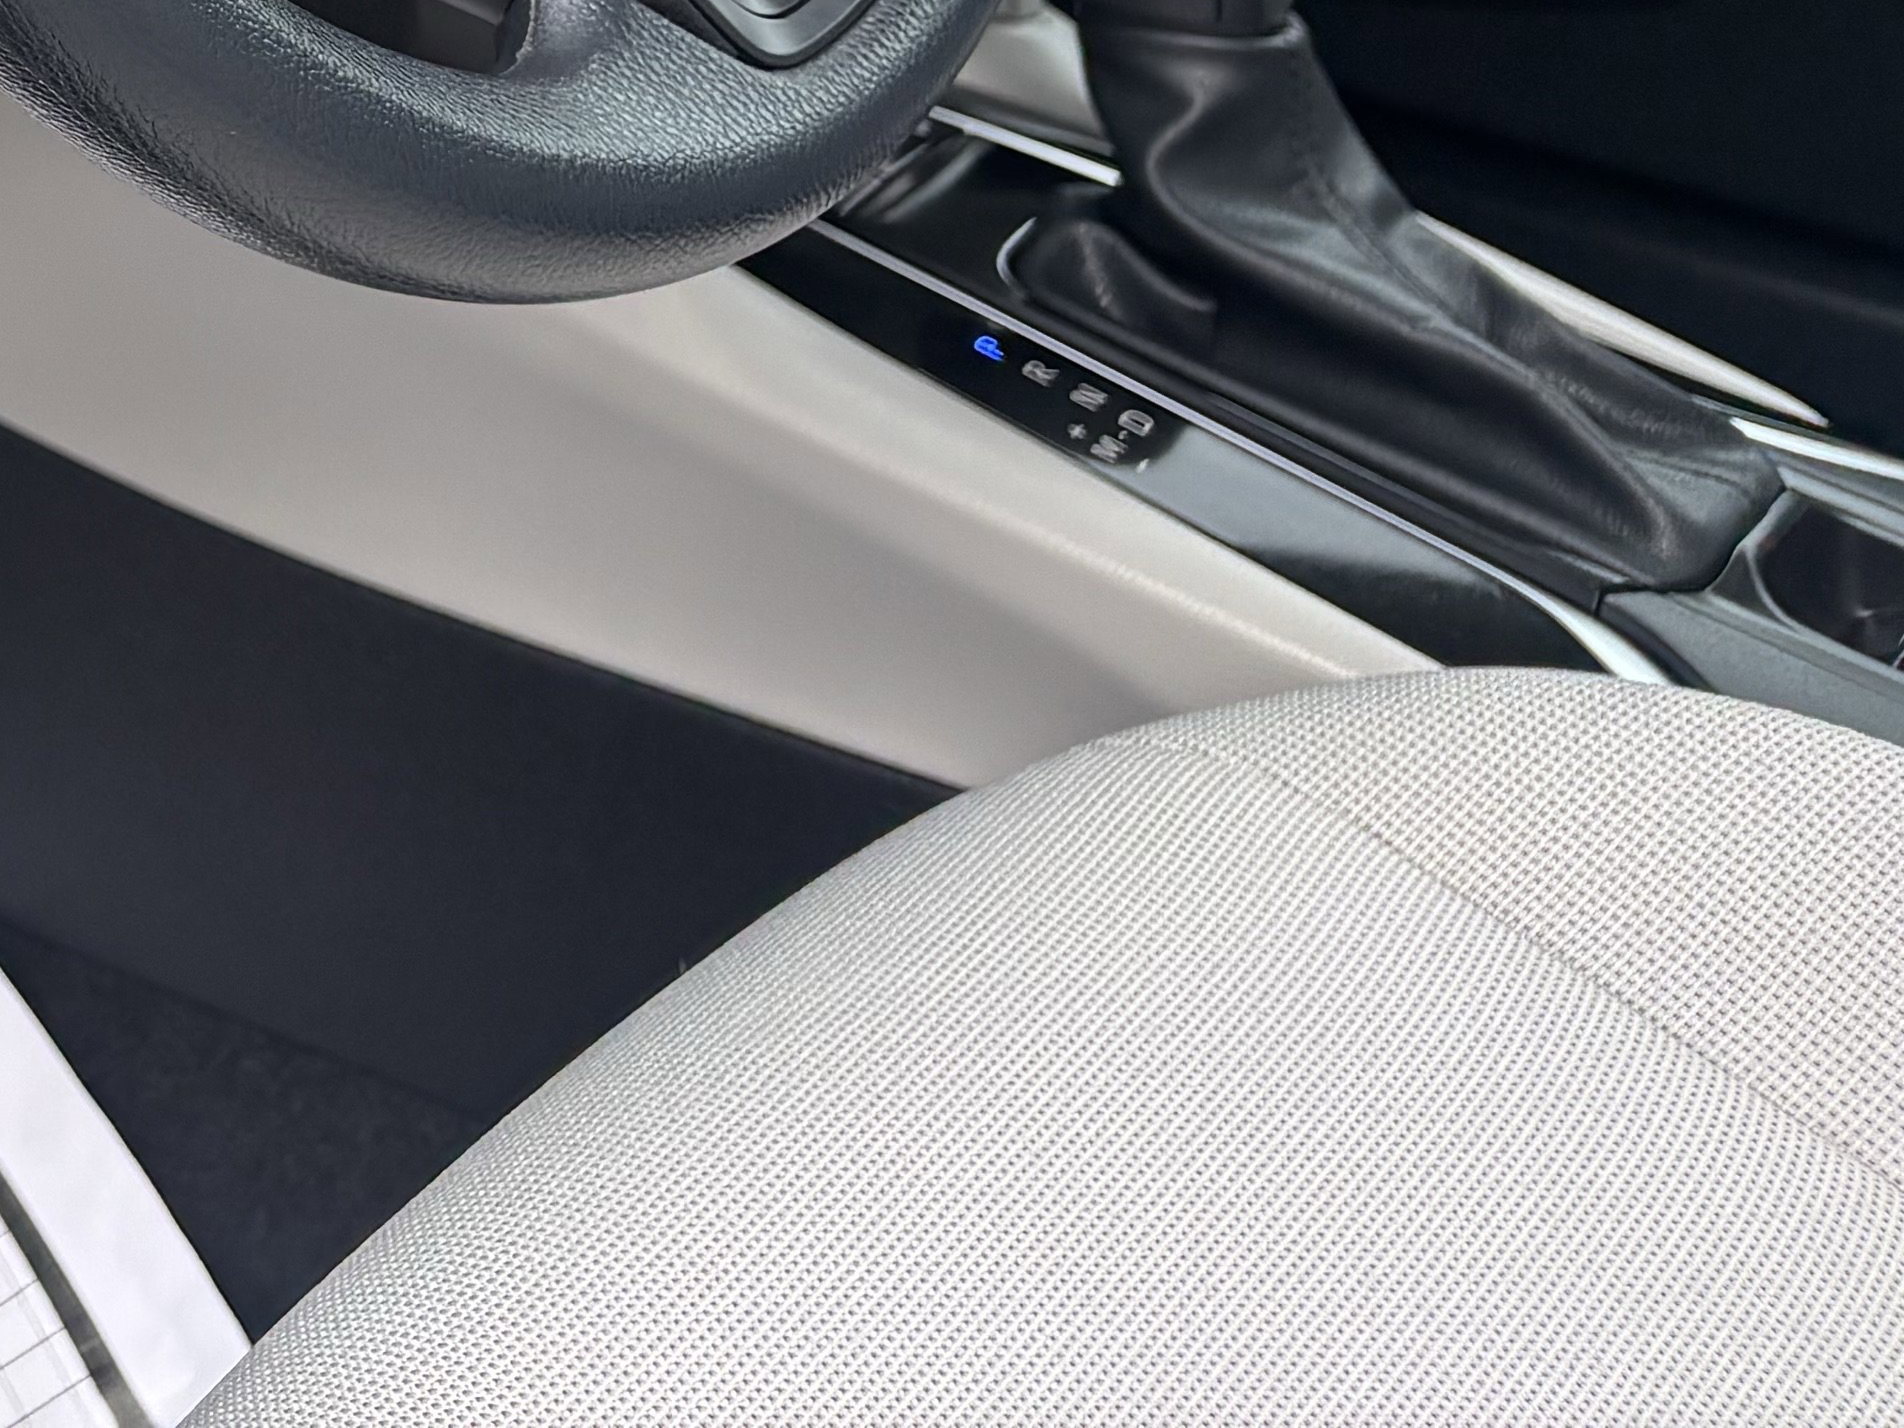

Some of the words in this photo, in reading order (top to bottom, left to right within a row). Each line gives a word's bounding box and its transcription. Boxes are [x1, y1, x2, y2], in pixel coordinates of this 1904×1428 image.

[973, 335, 1005, 361] P
[1021, 359, 1060, 387] R
[1069, 383, 1109, 412] N
[1117, 409, 1155, 436] D
